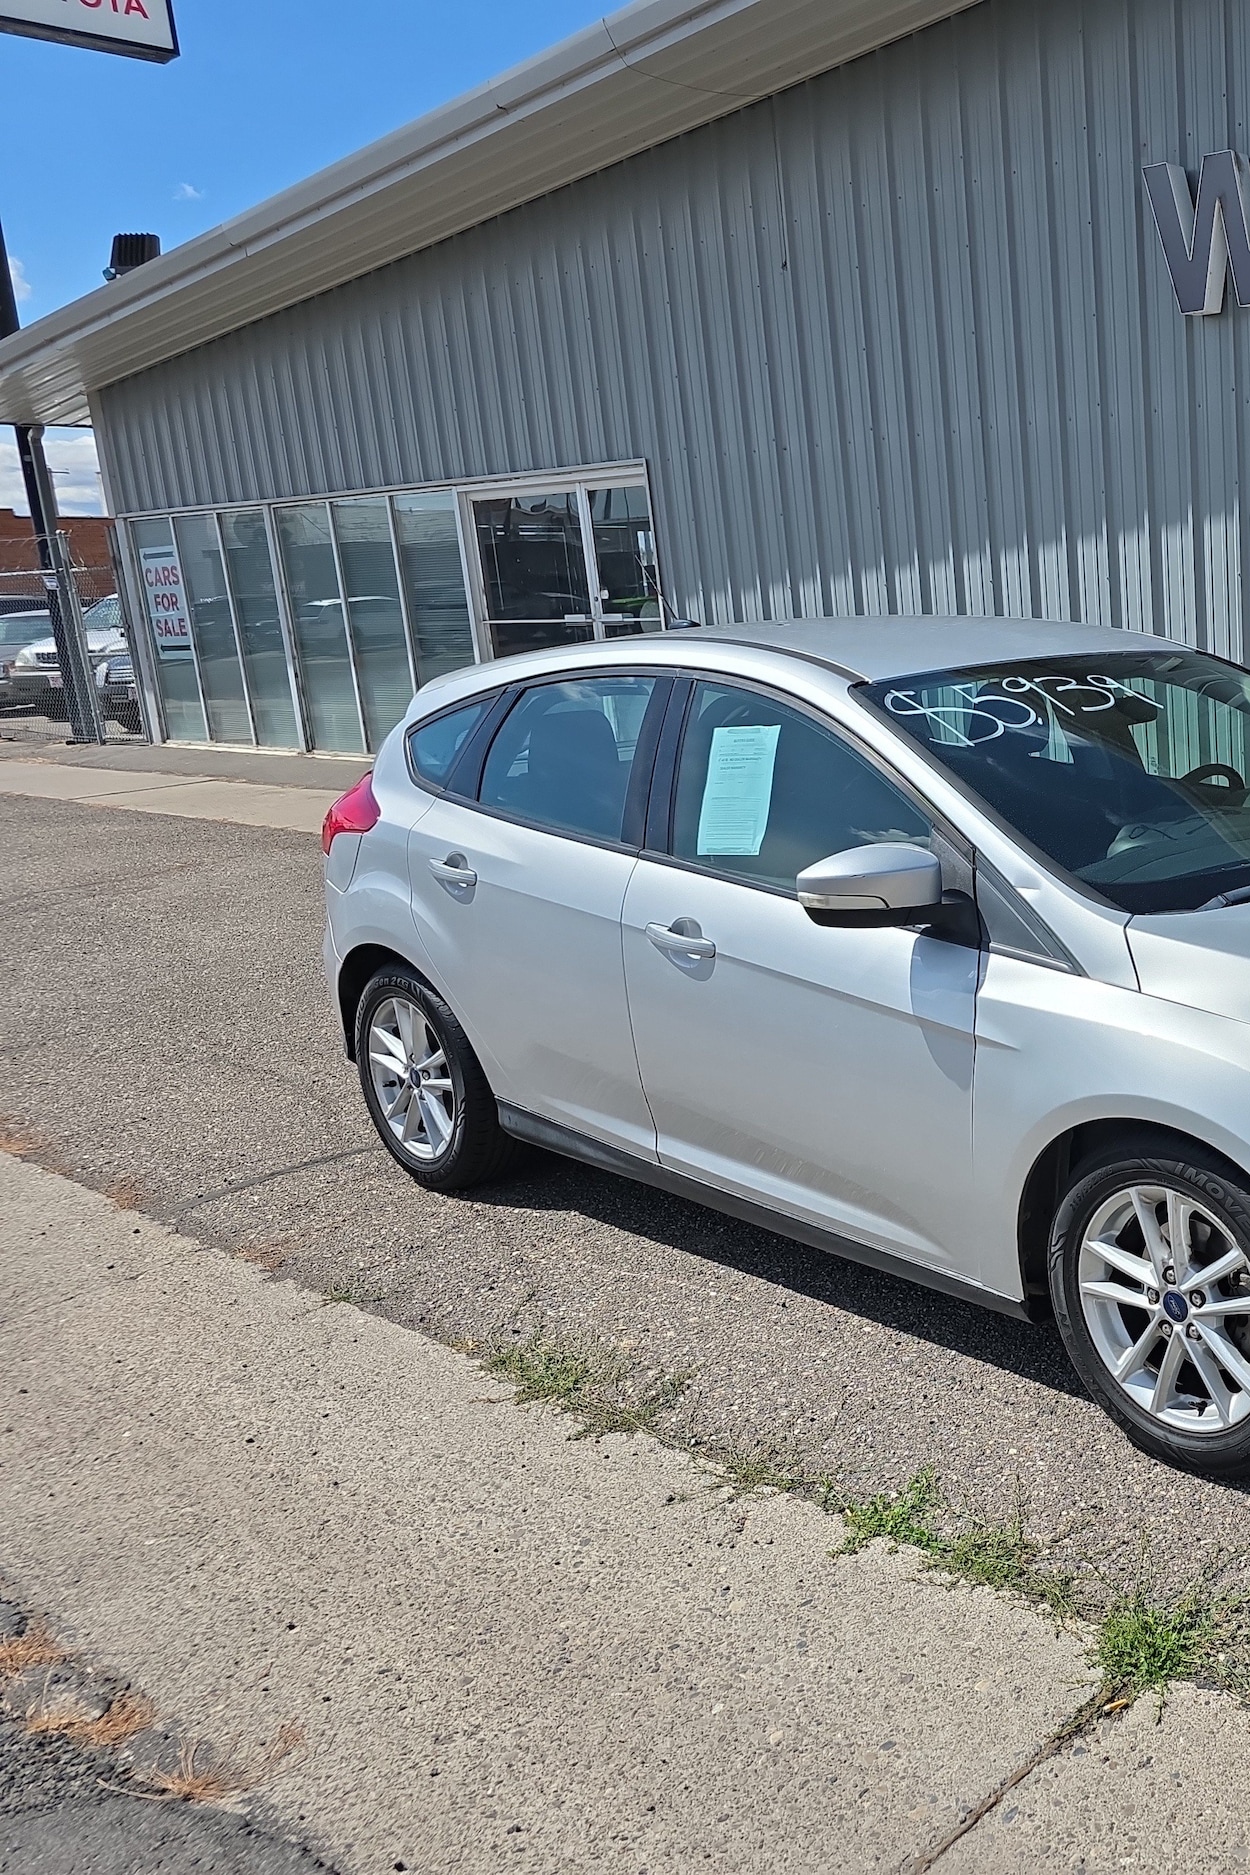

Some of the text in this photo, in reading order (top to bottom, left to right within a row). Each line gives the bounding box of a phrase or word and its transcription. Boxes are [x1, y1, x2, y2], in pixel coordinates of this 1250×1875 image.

[145, 565, 180, 588] CARS
[153, 593, 180, 612] FOR
[156, 618, 188, 638] SALE
